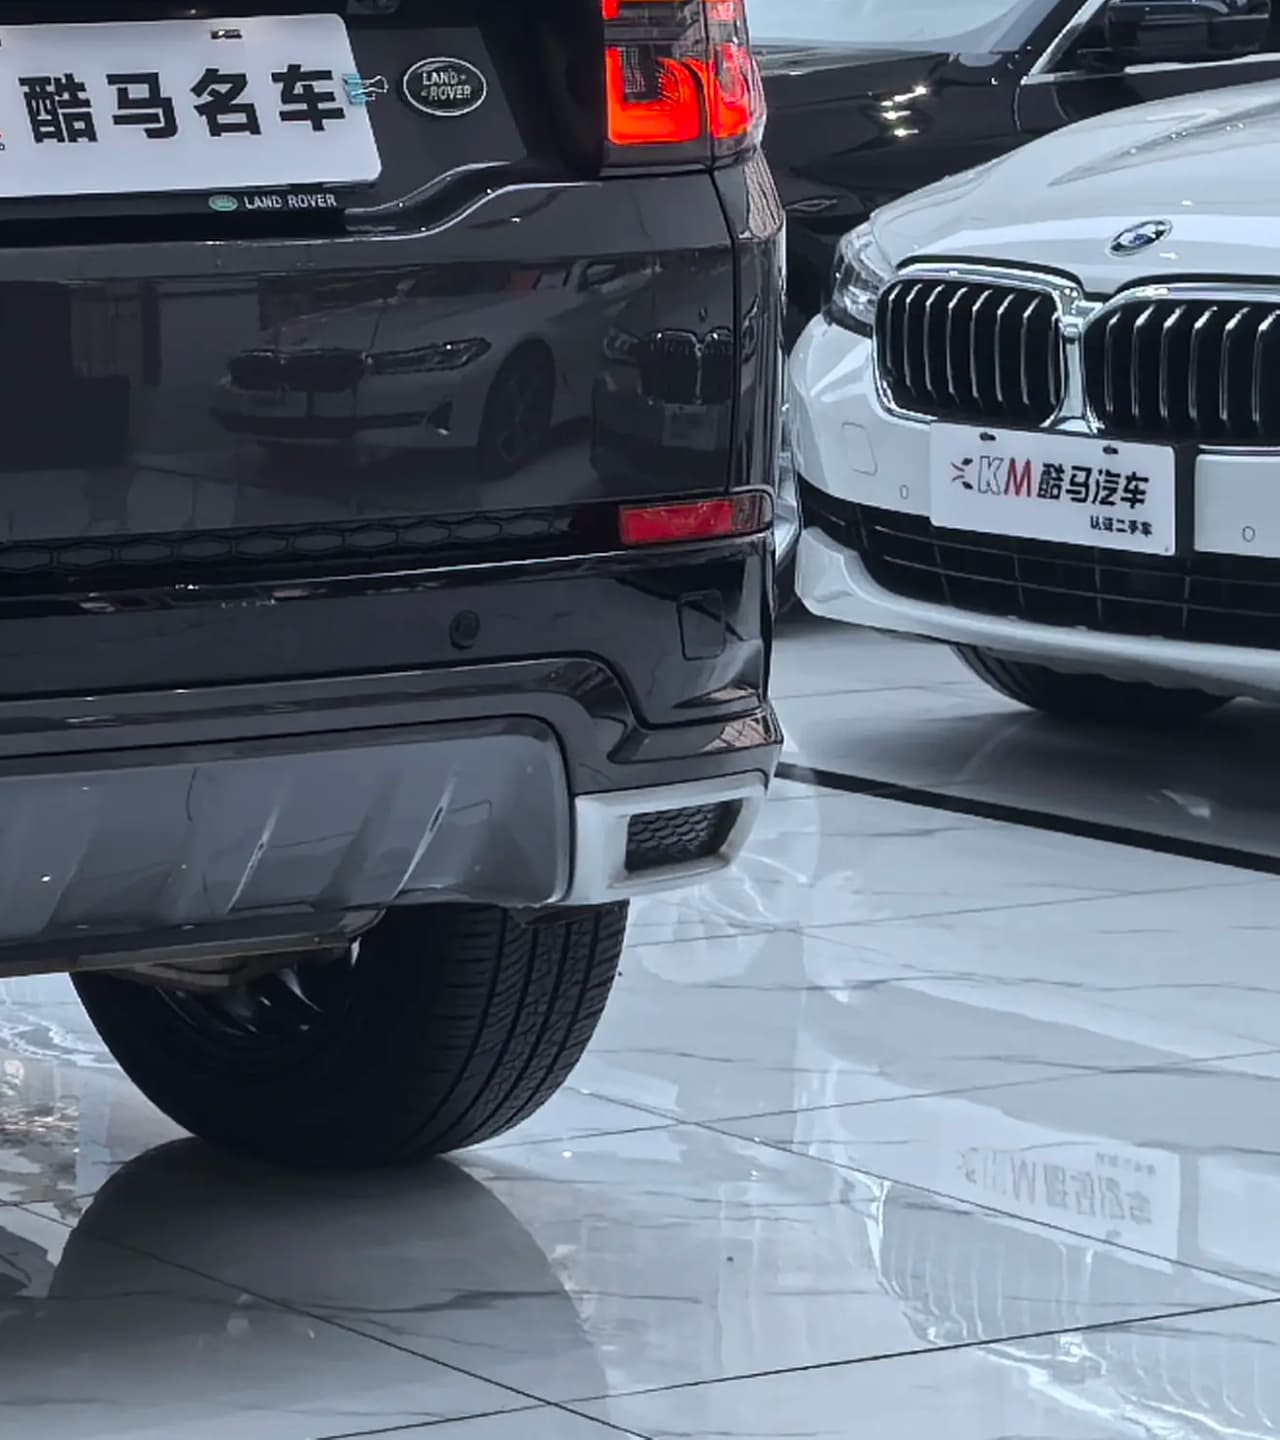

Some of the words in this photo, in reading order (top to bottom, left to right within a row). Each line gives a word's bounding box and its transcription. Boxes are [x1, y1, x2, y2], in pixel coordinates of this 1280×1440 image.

[423, 71, 458, 85] LAND
[429, 85, 471, 100] ROVER
[18, 63, 346, 144] 酷马名车
[244, 195, 281, 209] LAND
[287, 193, 336, 207] ROVER
[1037, 462, 1149, 509] 酷马汽车
